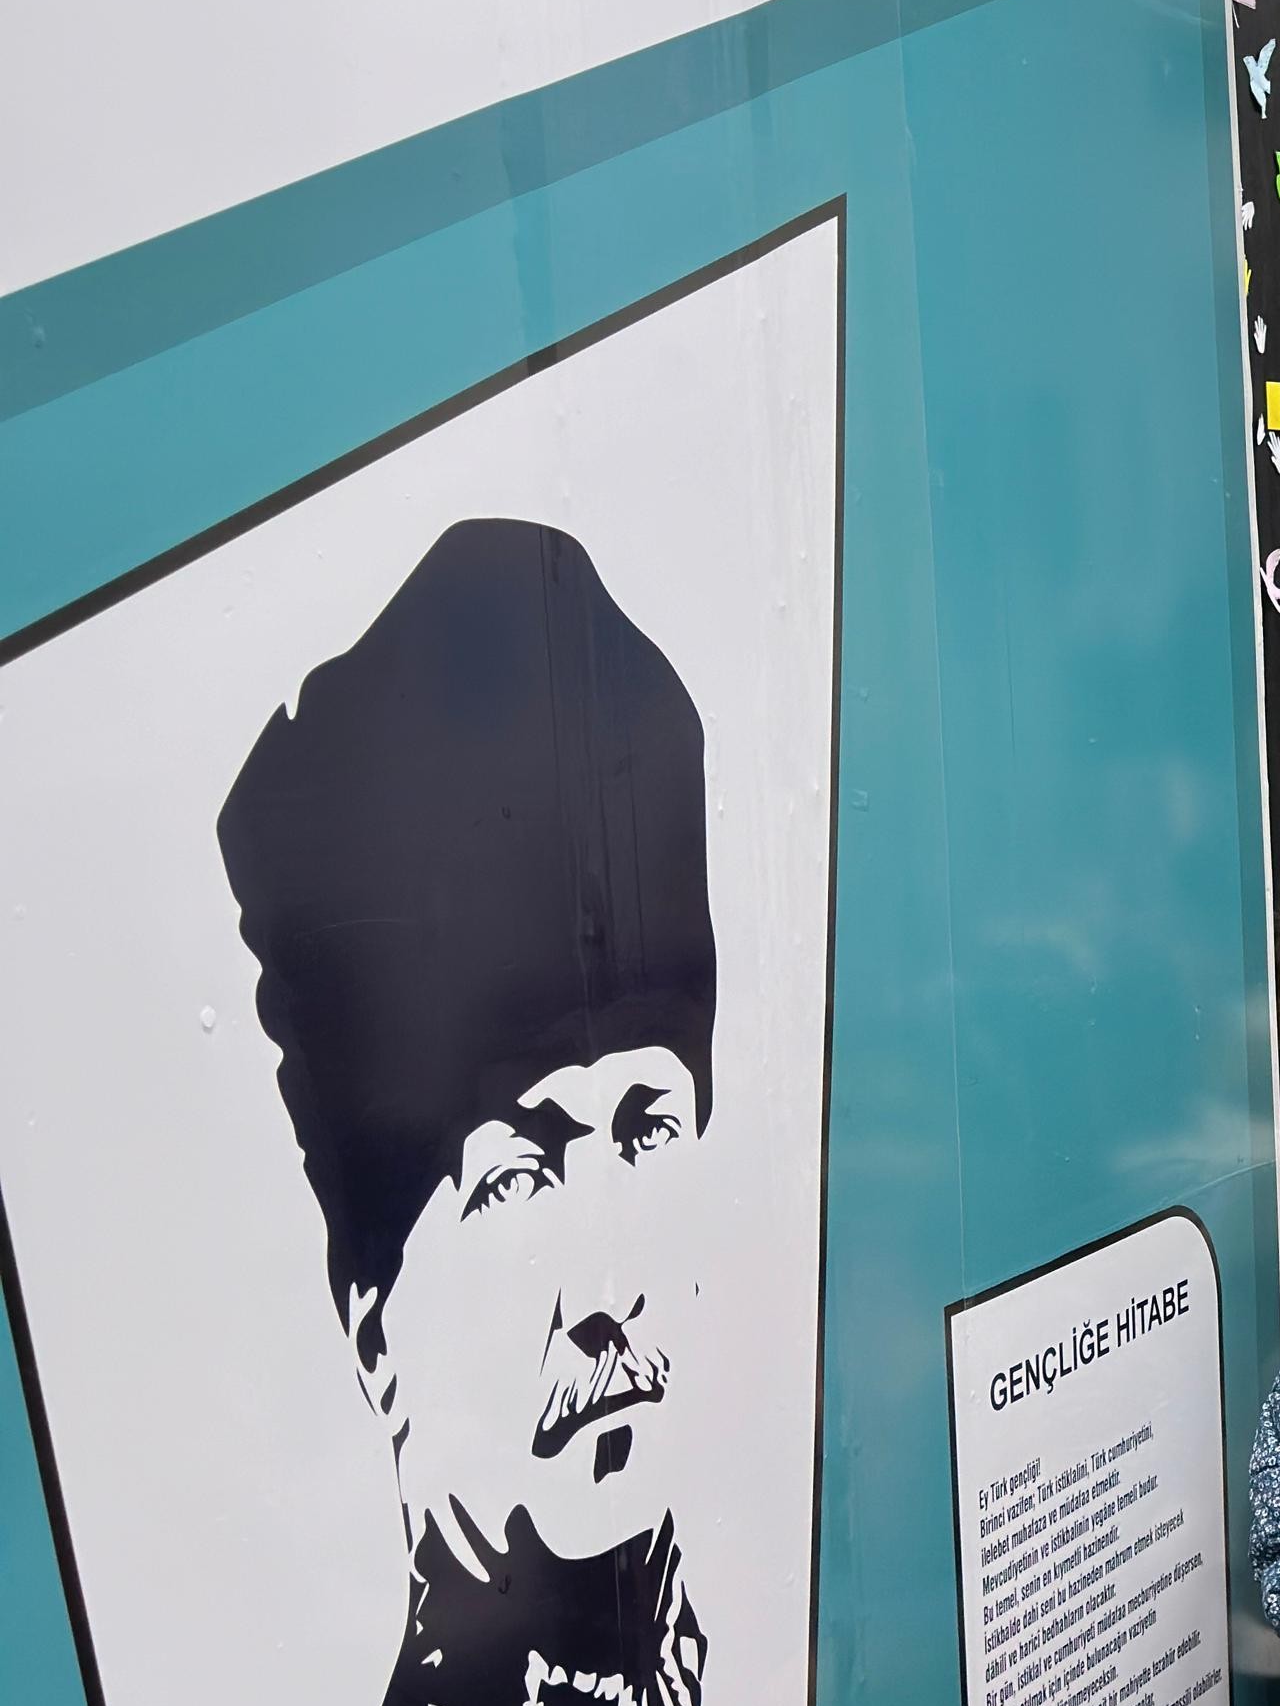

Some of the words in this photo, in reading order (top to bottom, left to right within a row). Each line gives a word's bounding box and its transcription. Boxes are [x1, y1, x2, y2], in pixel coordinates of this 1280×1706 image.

[990, 1320, 1109, 1410] GENÇLİĞE
[1117, 1280, 1189, 1346] HİTABE
[979, 1489, 989, 1511] Ey
[990, 1477, 1008, 1502] Türk
[1009, 1458, 1041, 1496] gençliği!
[980, 1507, 1005, 1538] Birinci
[1037, 1480, 1054, 1504] Türk
[981, 1535, 1010, 1567] ilelebet
[1011, 1515, 1047, 1548] muhafaza
[1048, 1509, 1058, 1526] ve
[1040, 1542, 1049, 1560] ve
[983, 1606, 994, 1626] Bu
[1021, 1575, 1041, 1601] senin
[1042, 1569, 1052, 1587] en
[1022, 1602, 1039, 1629] dahi
[1040, 1591, 1056, 1618] seni
[1057, 1588, 1067, 1606] bu
[1008, 1650, 1018, 1667] ve
[1017, 1658, 1042, 1691] istiklal
[1043, 1655, 1052, 1672] ve
[1048, 1676, 1062, 1701] için
